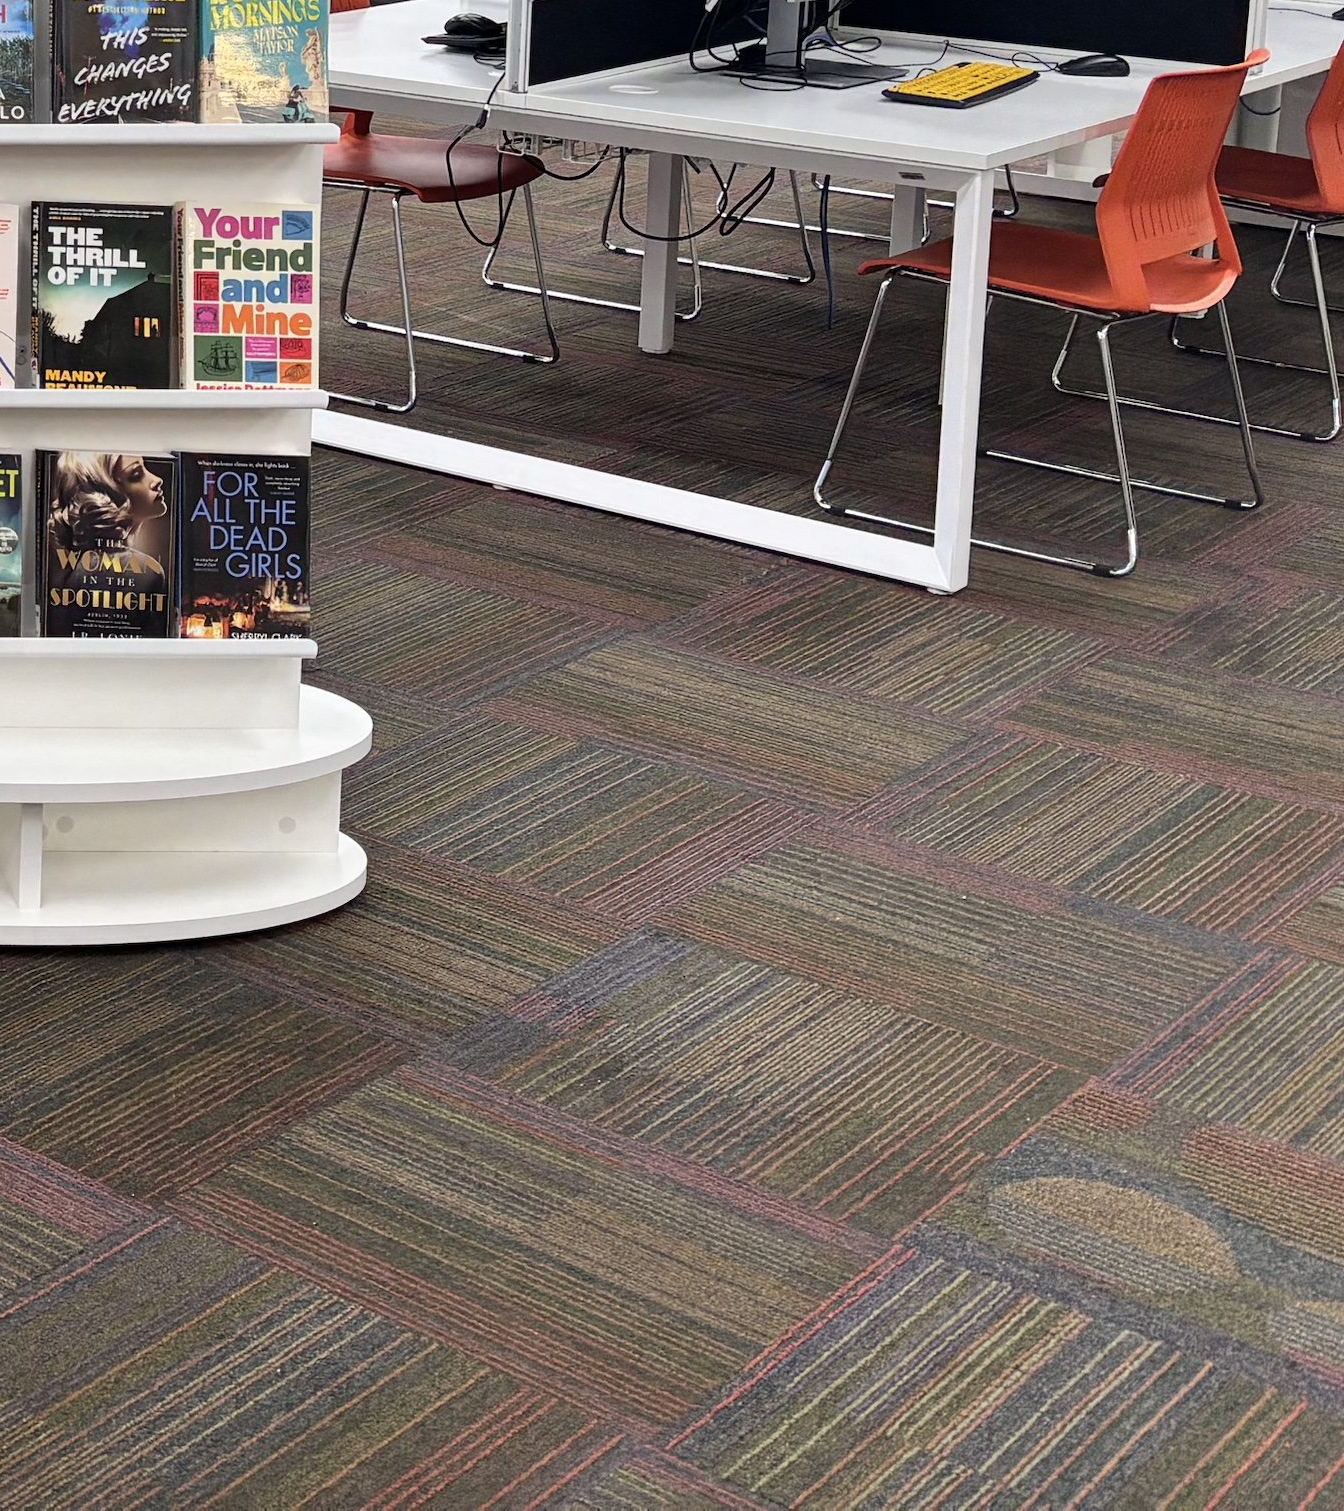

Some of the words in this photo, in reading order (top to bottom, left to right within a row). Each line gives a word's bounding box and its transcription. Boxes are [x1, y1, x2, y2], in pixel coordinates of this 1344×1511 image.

[193, 208, 280, 240] Your
[48, 247, 147, 269] THRILL
[193, 240, 313, 272] Friend
[222, 304, 312, 336] Mine
[45, 369, 107, 383] MANDY
[202, 470, 259, 497] FOR
[210, 525, 287, 552] DEAD
[225, 553, 302, 580] GIRLS
[50, 588, 166, 612] SPOTLIGHT
